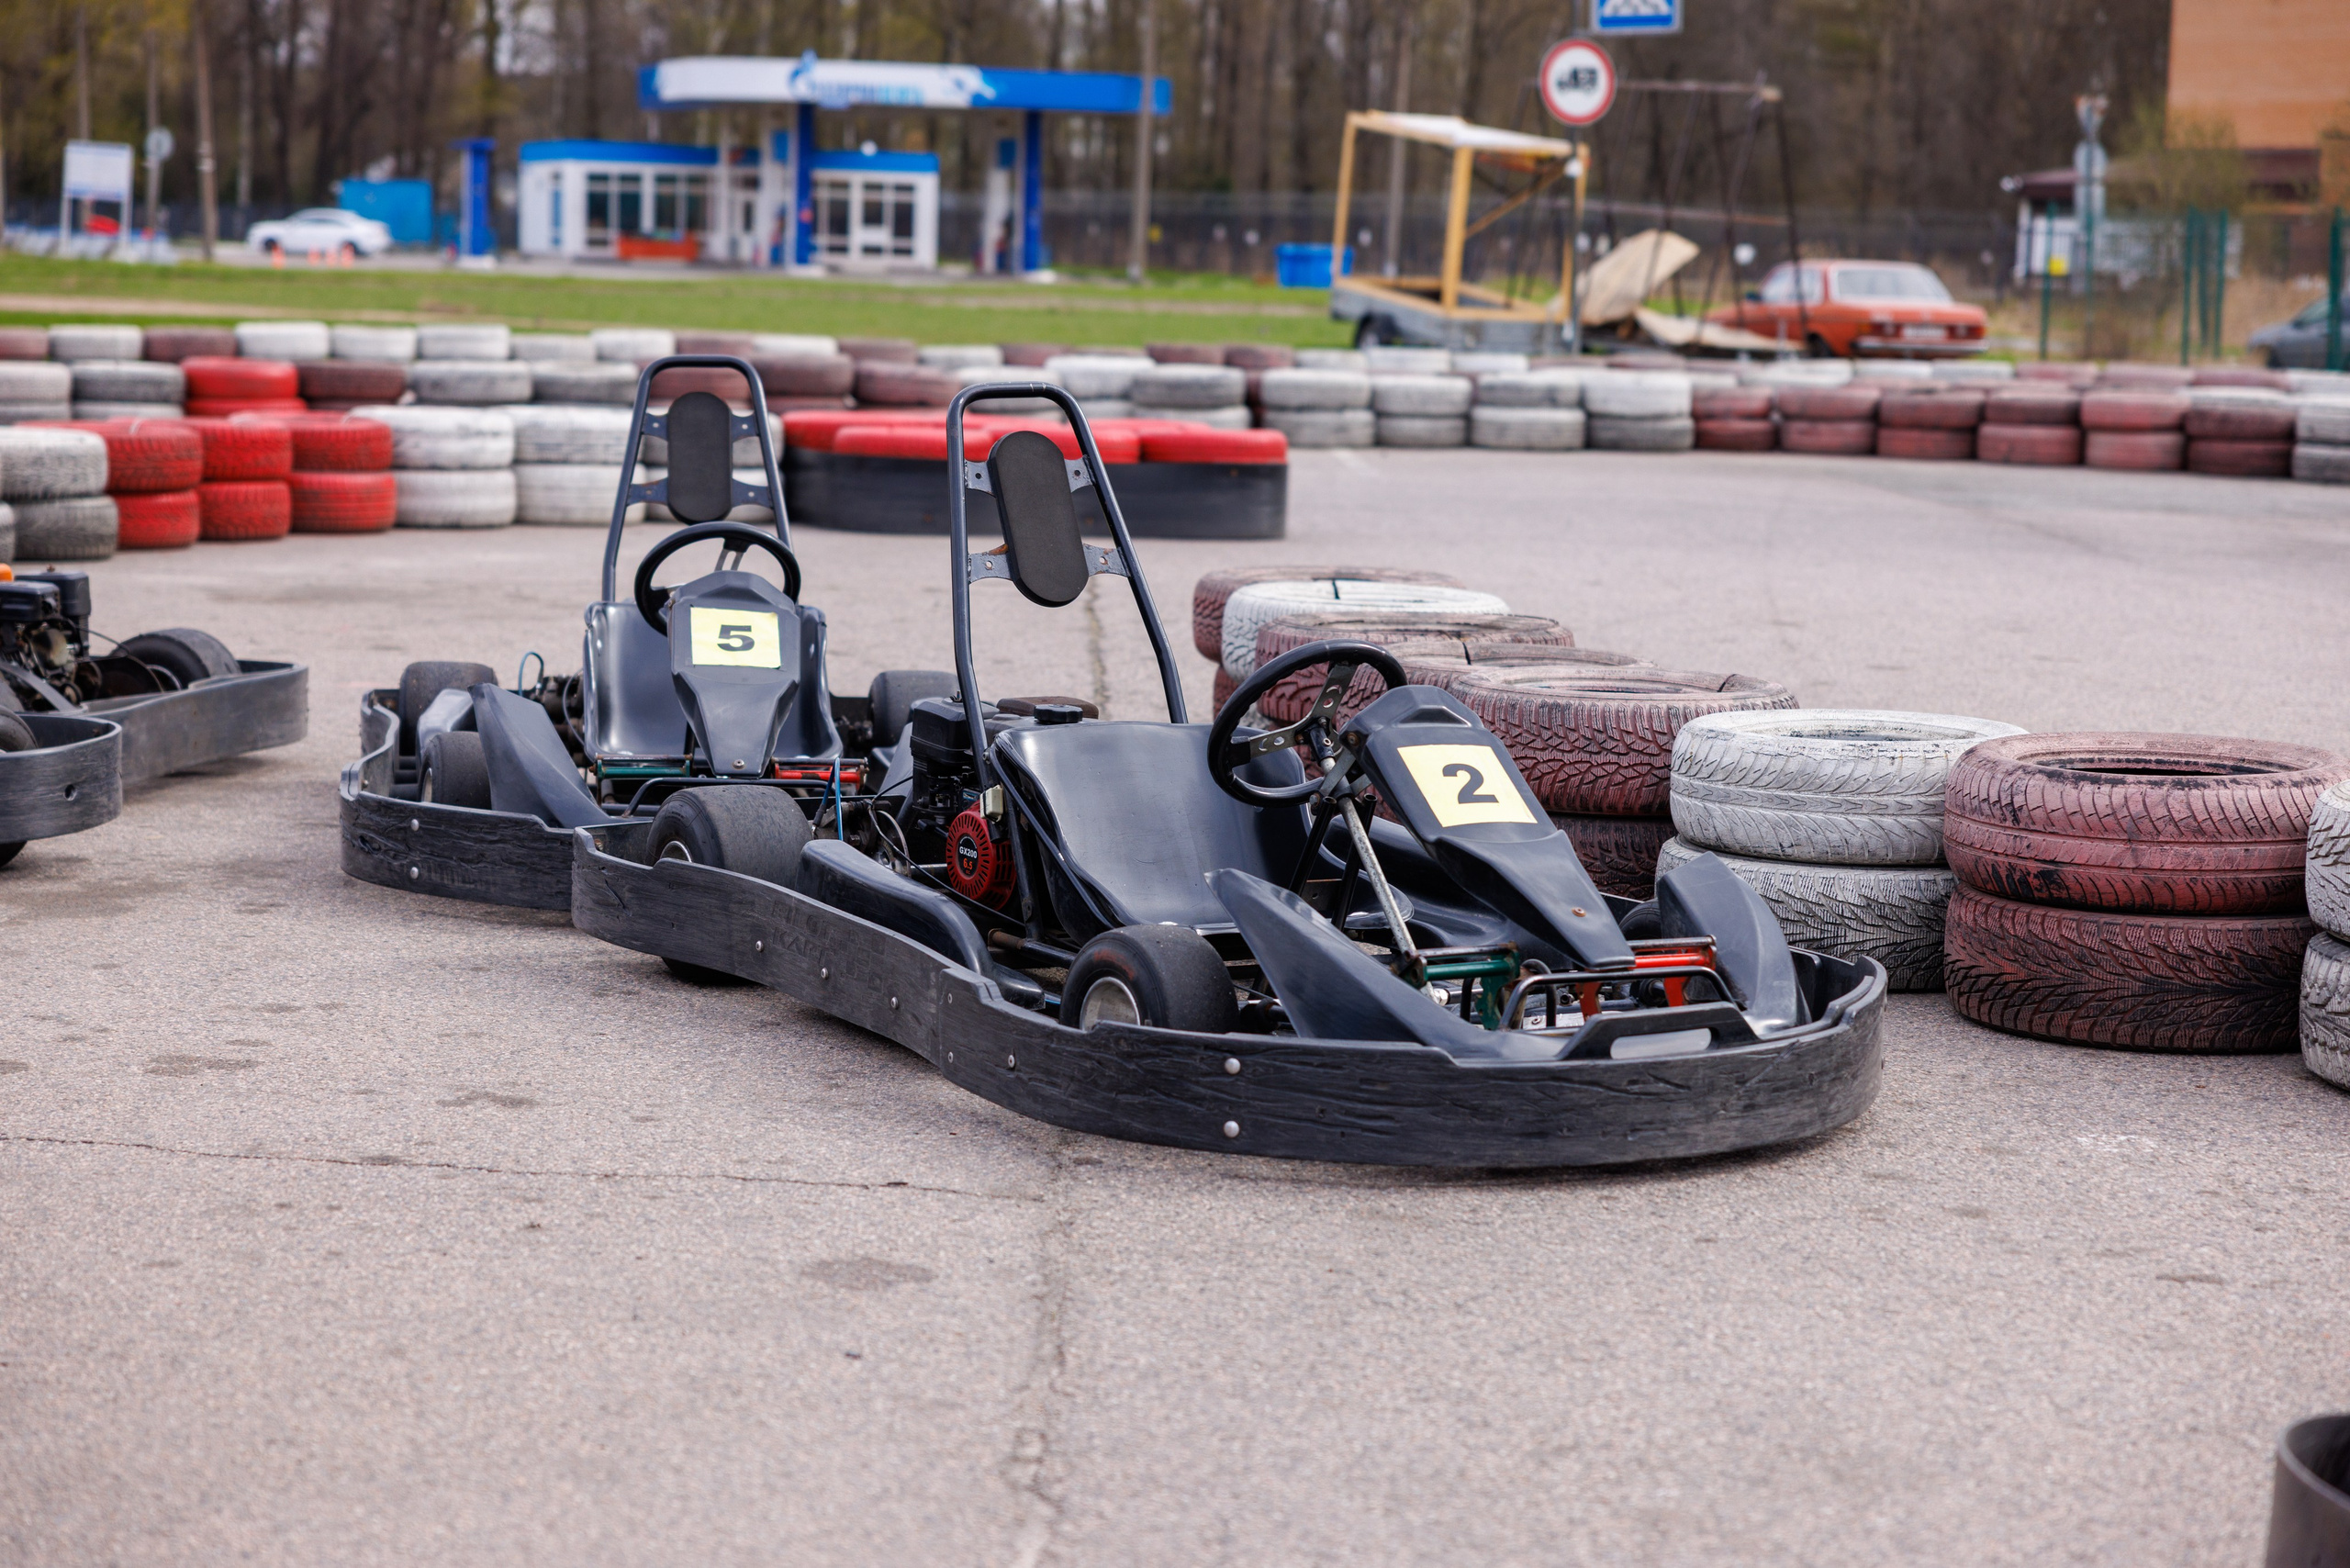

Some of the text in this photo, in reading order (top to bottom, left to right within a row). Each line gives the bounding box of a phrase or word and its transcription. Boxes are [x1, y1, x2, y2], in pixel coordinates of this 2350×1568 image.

[717, 624, 755, 652] 5
[1442, 764, 1499, 804] 2
[959, 846, 978, 858] GX200
[964, 858, 973, 869] 6.5
